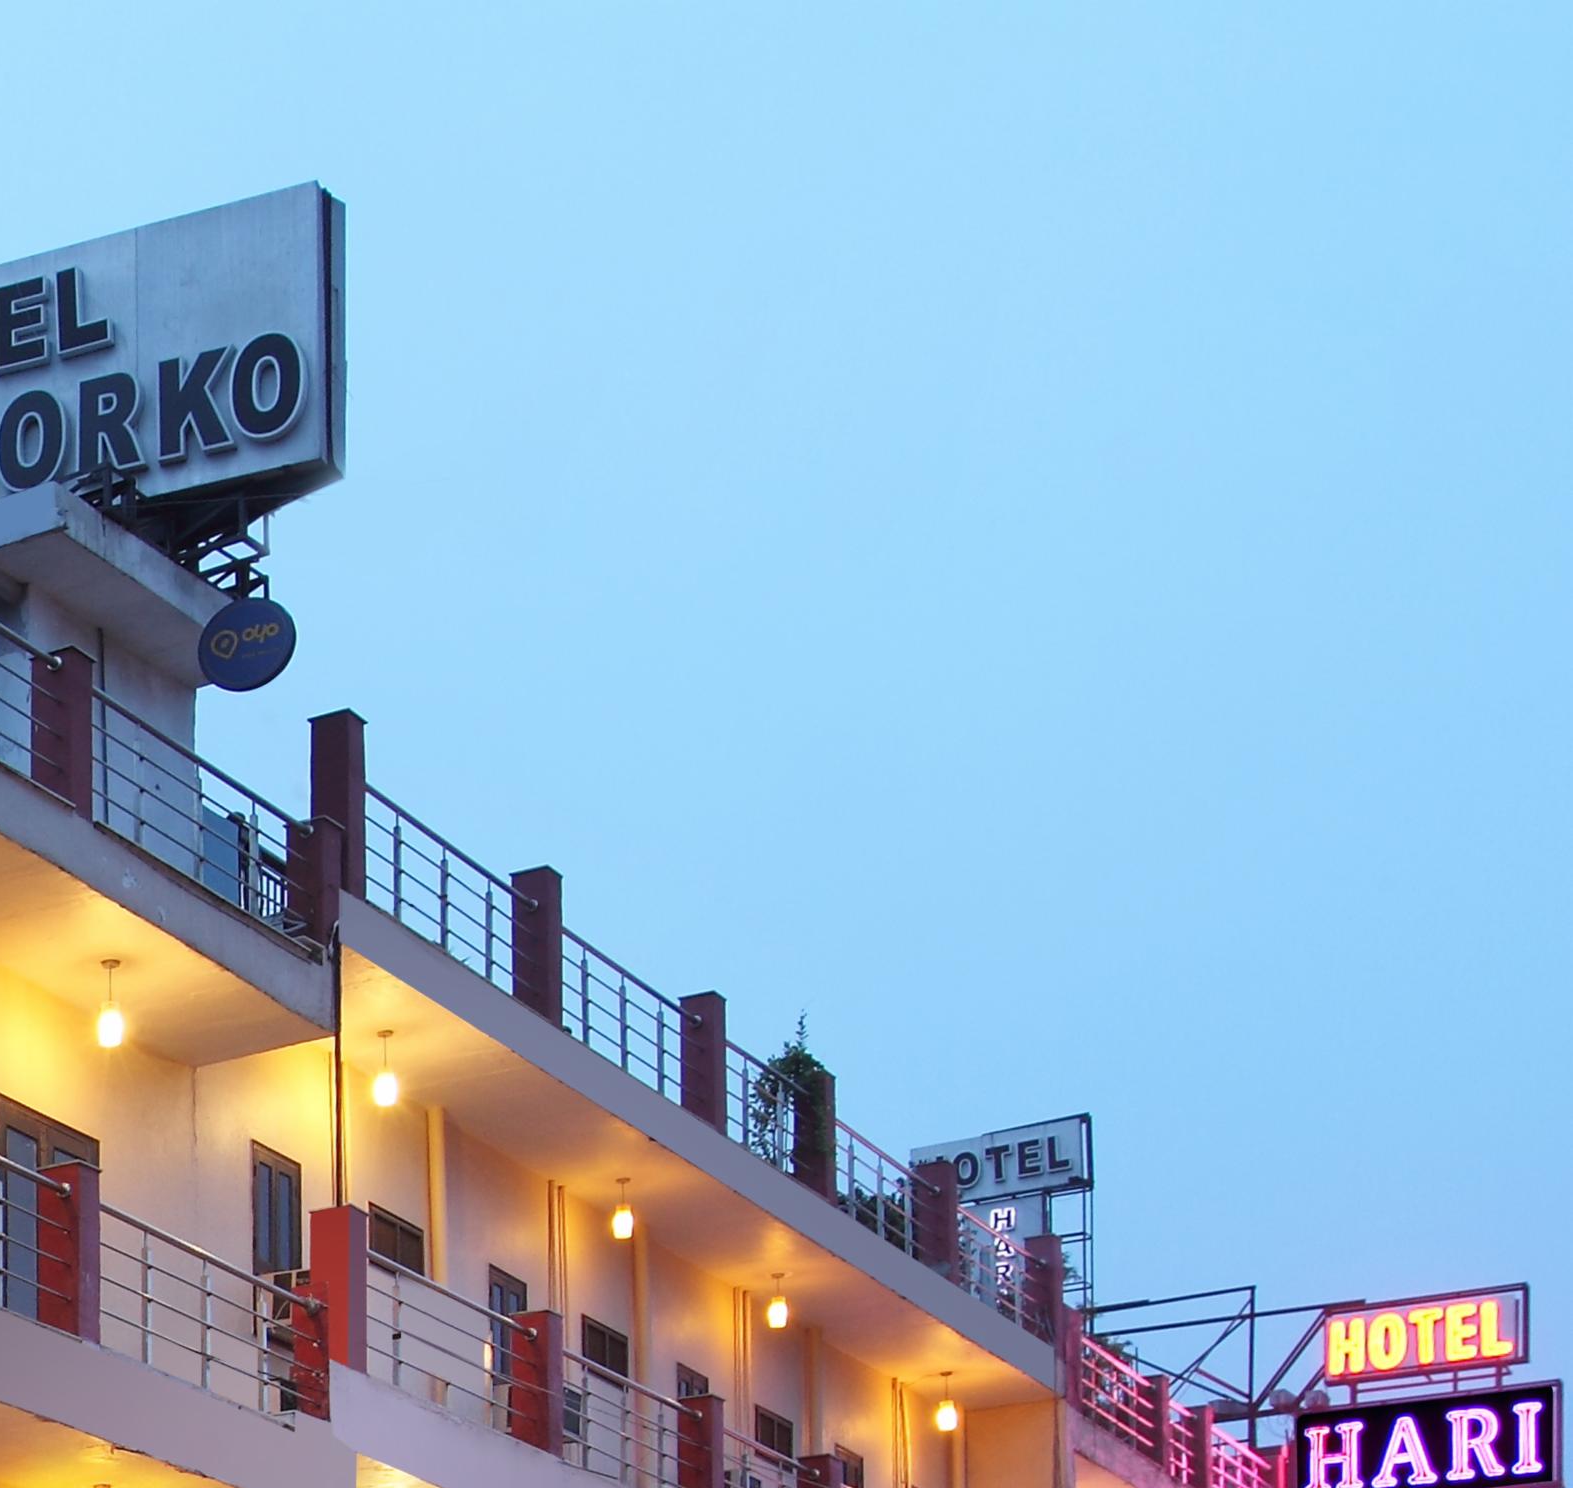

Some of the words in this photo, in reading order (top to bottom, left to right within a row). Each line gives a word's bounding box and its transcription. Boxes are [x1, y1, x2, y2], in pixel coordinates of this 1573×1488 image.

[242, 623, 279, 643] oyo
[934, 1134, 1072, 1188] OTEL
[1328, 1299, 1514, 1378] HOTEL
